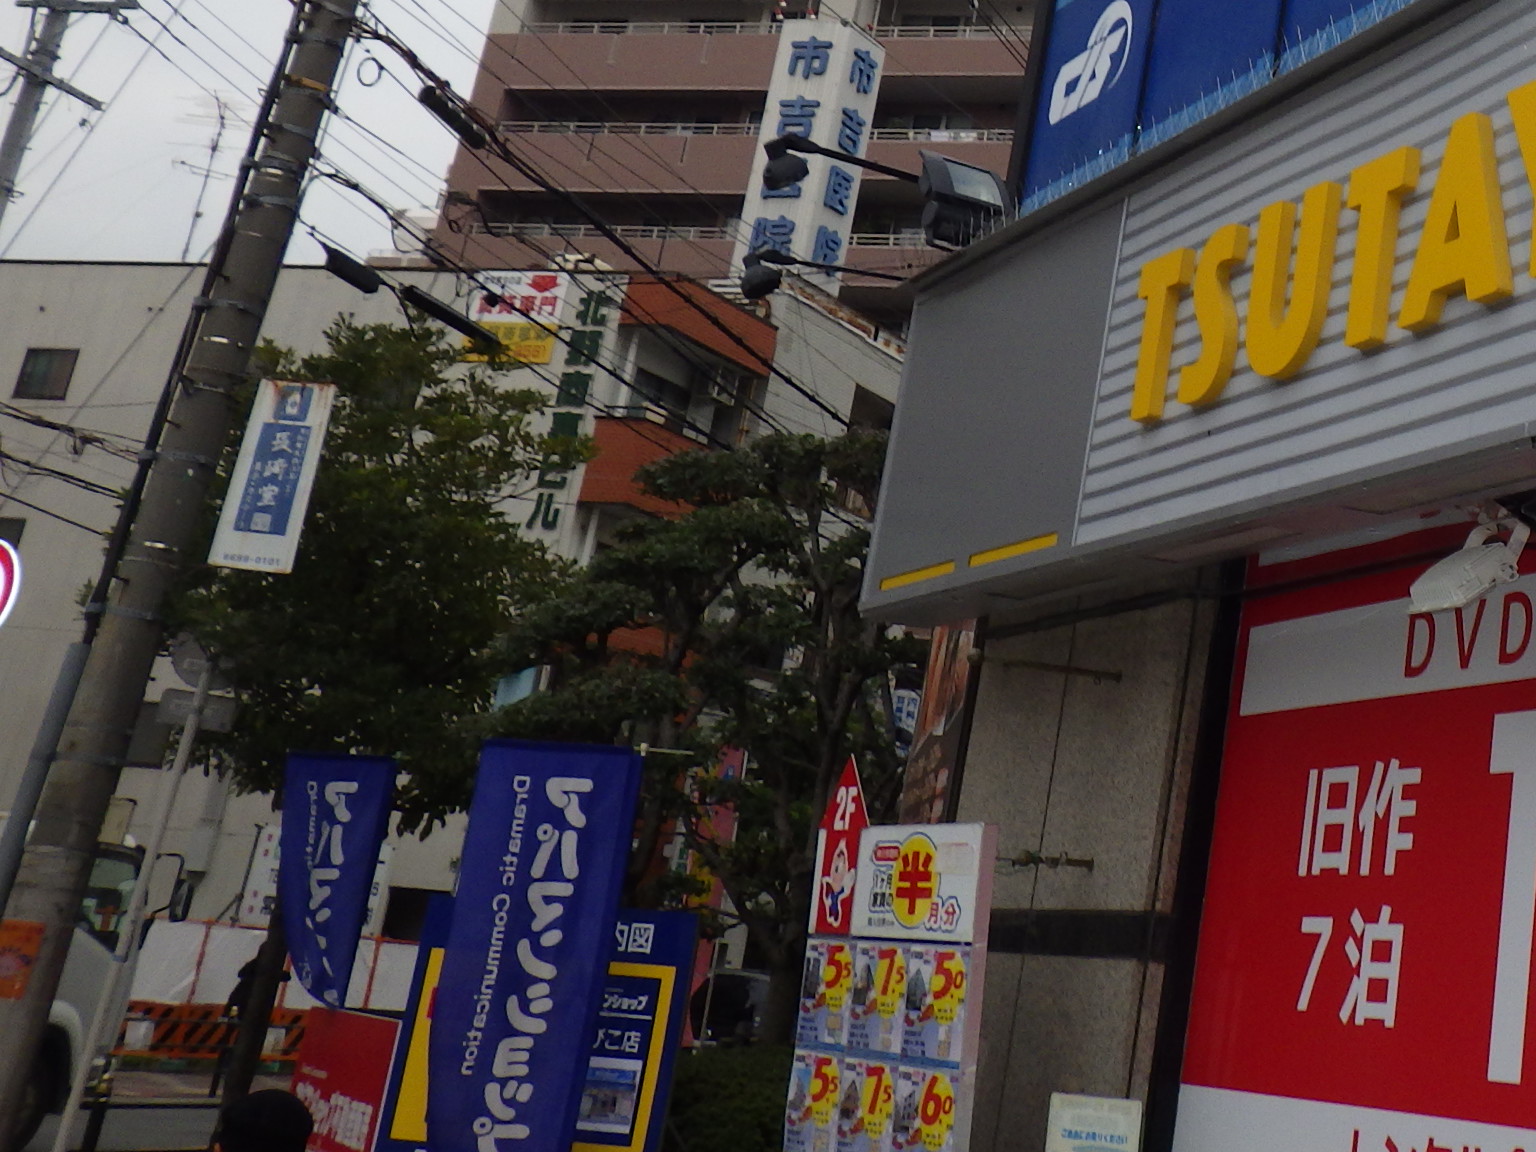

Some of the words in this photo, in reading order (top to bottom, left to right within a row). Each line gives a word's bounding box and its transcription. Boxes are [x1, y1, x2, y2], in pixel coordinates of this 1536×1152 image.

[750, 35, 834, 256] 市吉院
[833, 786, 858, 831] 2F
[1297, 757, 1421, 878] 旧作
[1296, 904, 1405, 1029] 7泊
